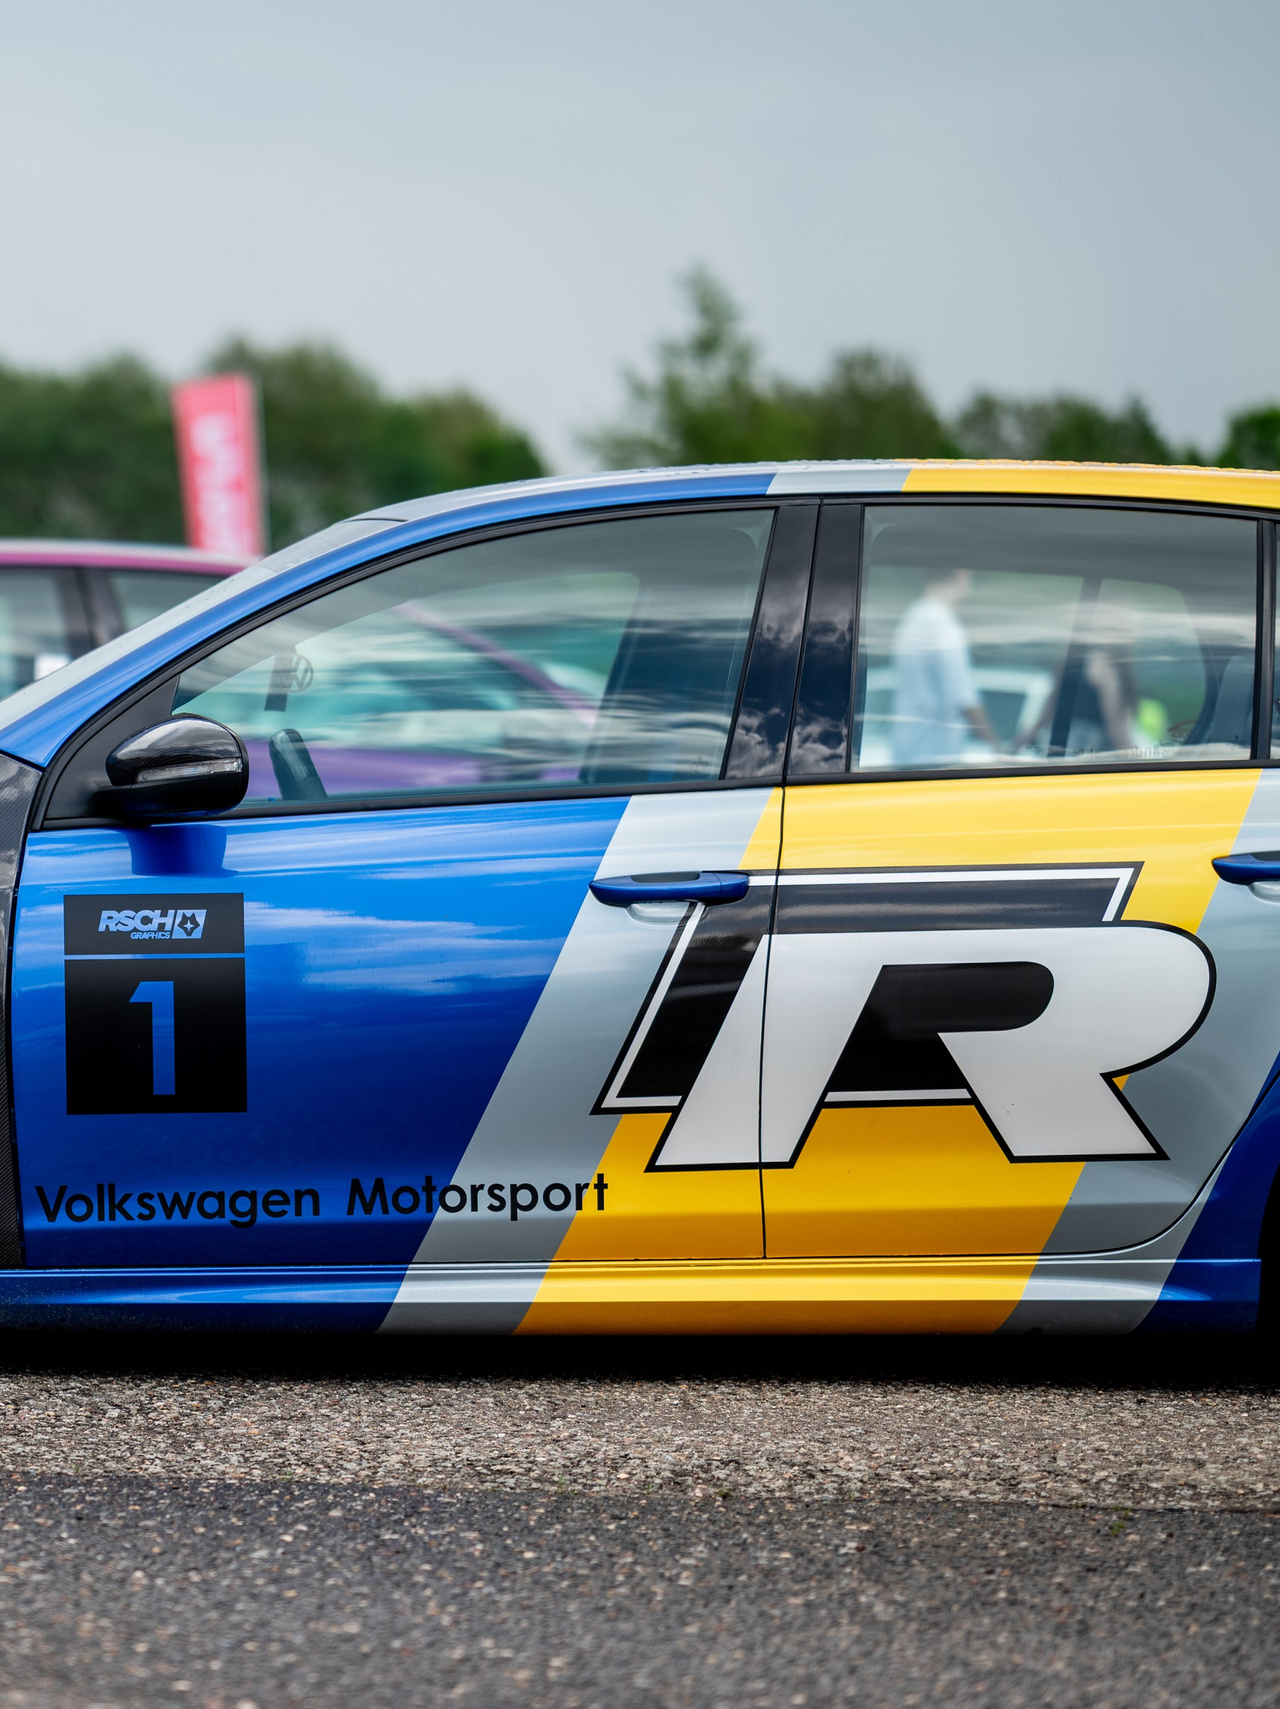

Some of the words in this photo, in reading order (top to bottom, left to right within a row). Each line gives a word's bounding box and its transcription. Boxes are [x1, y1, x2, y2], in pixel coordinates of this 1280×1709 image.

[98, 909, 175, 932] RSCH
[130, 931, 170, 940] GRAPHICS
[129, 981, 176, 1095] 1
[35, 1183, 321, 1229] Volkswagen
[346, 1173, 608, 1221] Motorsport
